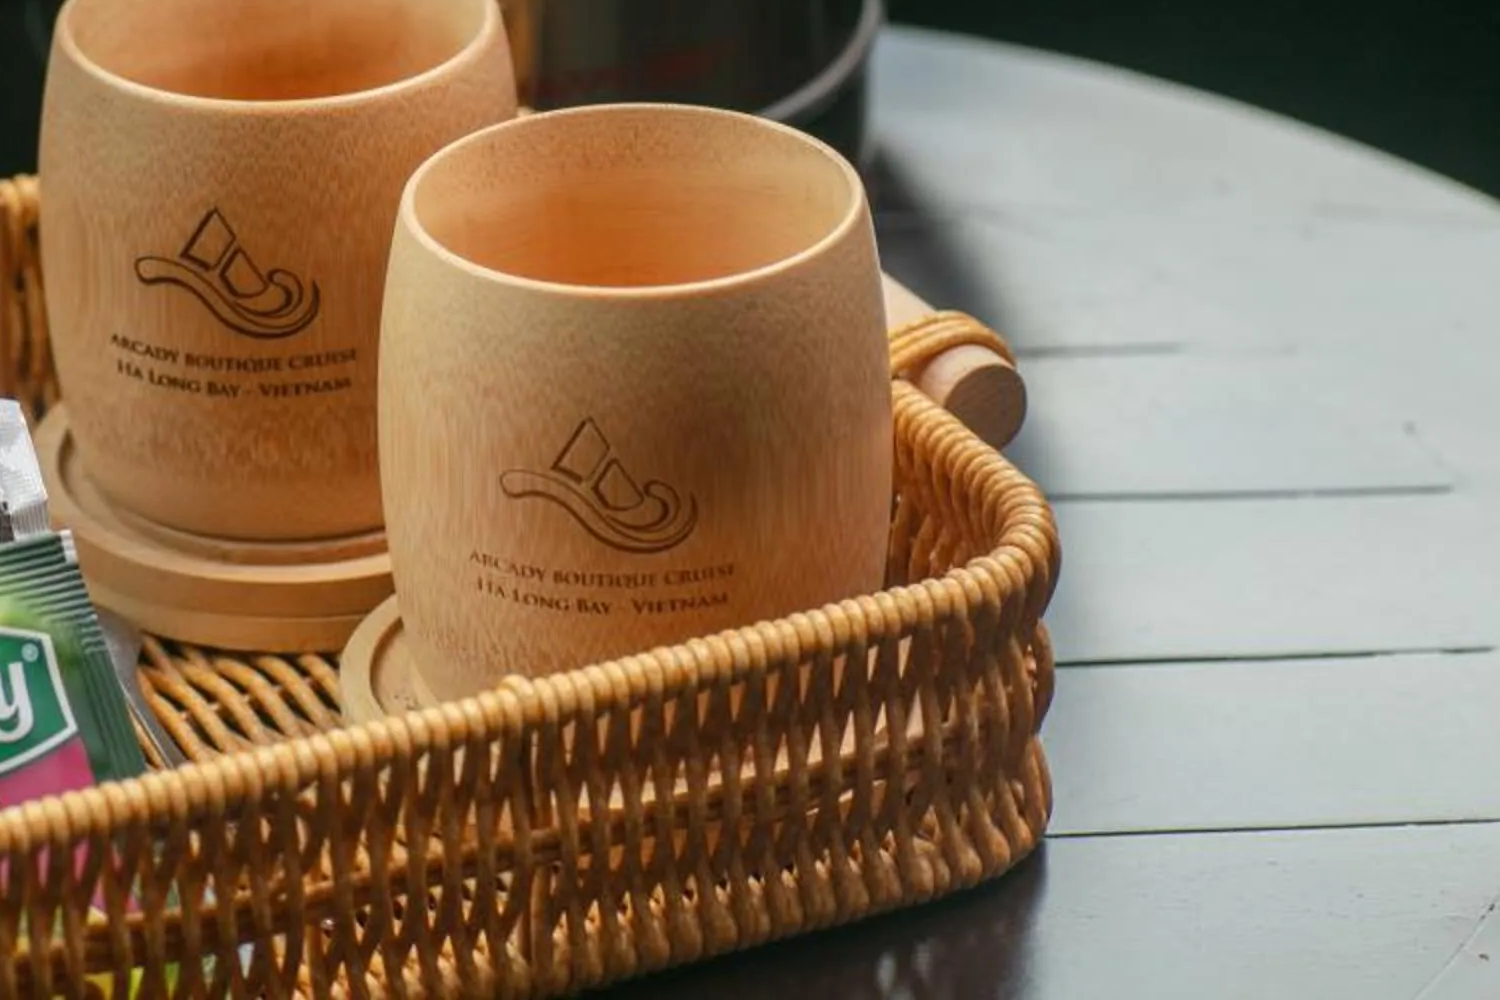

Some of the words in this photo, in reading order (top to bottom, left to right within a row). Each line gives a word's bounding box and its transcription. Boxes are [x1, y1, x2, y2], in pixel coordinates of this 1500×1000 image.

[110, 333, 181, 364] ARCADY
[184, 352, 282, 374] BOUTIQUE
[288, 348, 357, 371] CRUISE
[116, 359, 145, 379] HA
[149, 370, 202, 394] LONG
[206, 381, 242, 398] BAY
[258, 377, 352, 398] VIETNAM
[469, 550, 548, 582] ARCADY
[553, 570, 658, 590] BOUTIQUE
[664, 563, 735, 586] CRUISE
[476, 576, 507, 599] HA
[512, 588, 572, 613] LONG
[576, 600, 613, 616] BAY
[632, 592, 730, 615] VIETNAM
